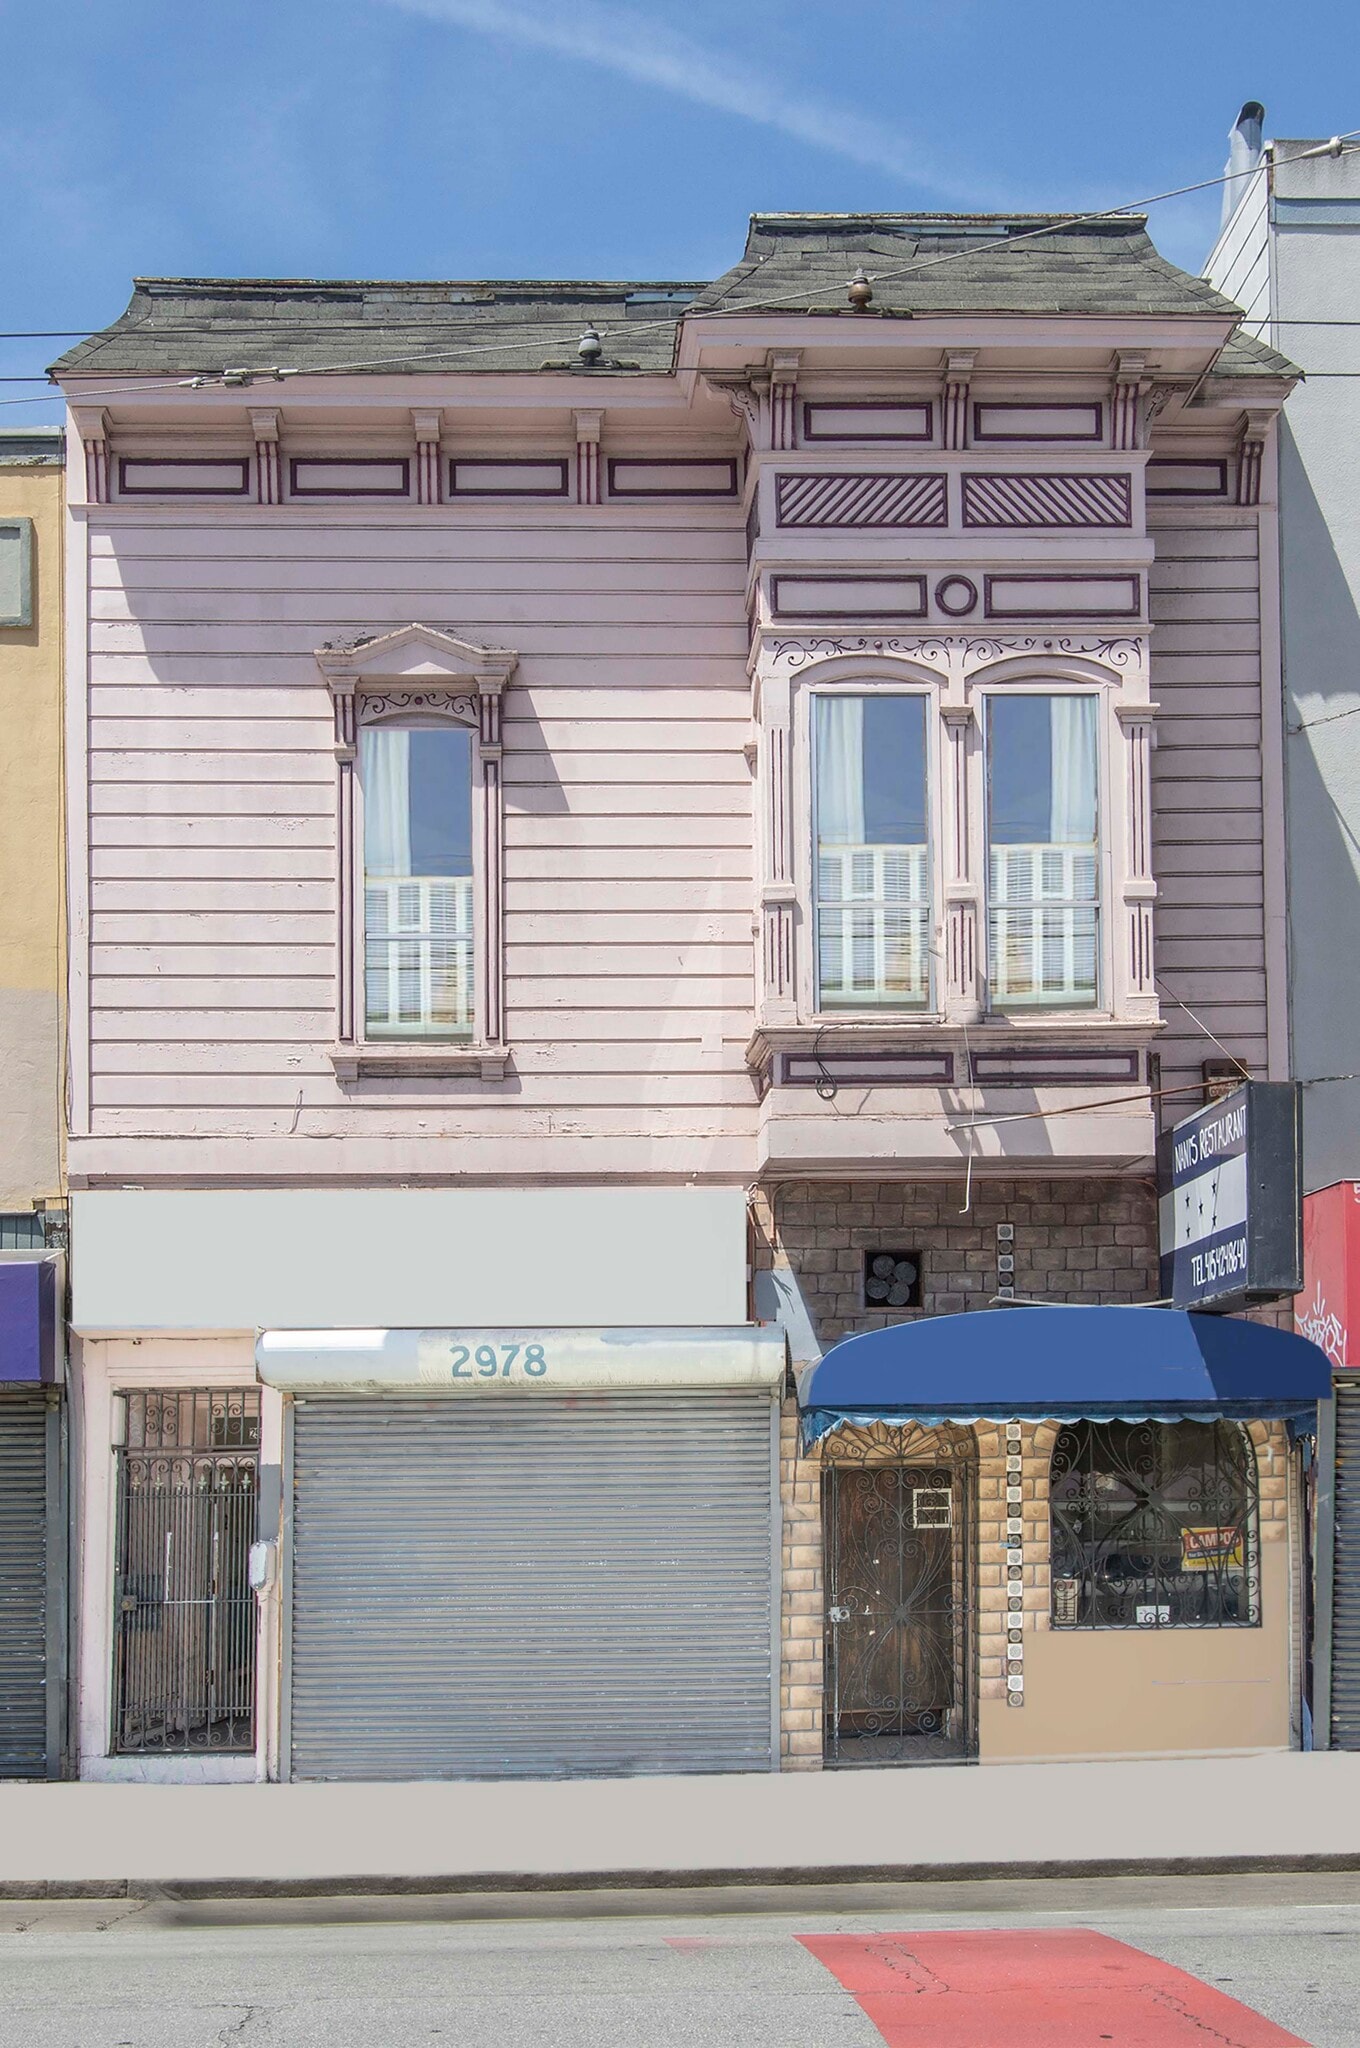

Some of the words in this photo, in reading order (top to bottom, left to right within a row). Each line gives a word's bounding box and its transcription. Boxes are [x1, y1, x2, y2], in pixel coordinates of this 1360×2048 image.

[1199, 1104, 1247, 1160] RESTAURANT
[449, 1344, 547, 1377] 2978
[1189, 1531, 1239, 1549] CAMPOS
